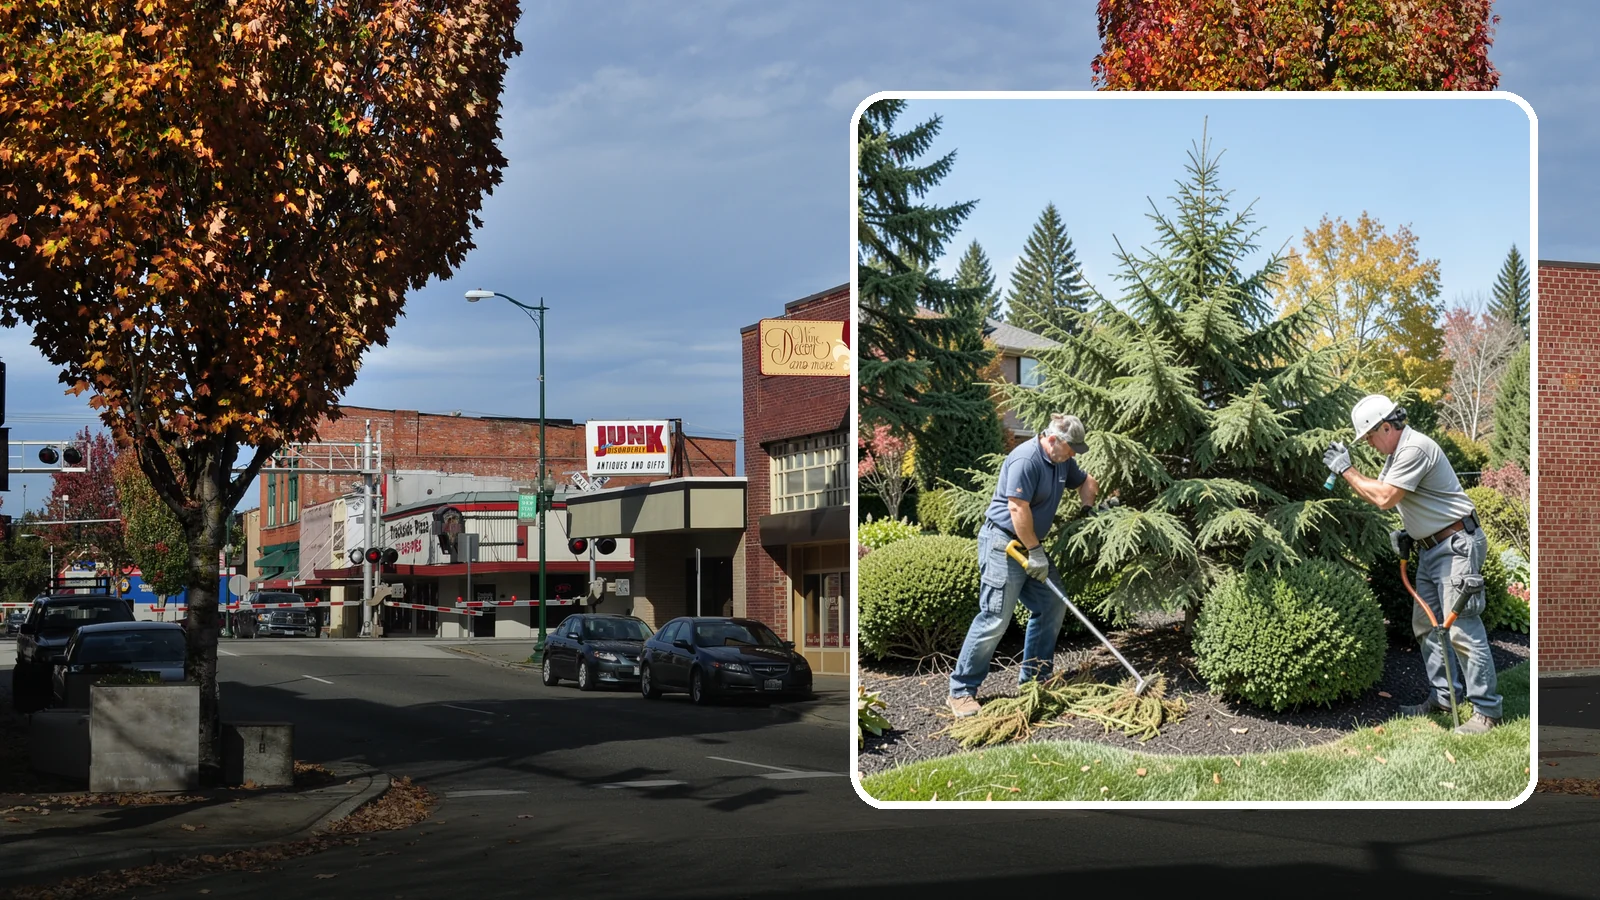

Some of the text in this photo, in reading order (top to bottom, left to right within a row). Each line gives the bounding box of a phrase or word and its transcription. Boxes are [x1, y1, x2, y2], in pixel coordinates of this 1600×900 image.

[596, 425, 665, 457] JUNK
[608, 446, 646, 454] DISORDERLY
[597, 460, 665, 470] ANTIQUES AND GIFTS
[390, 519, 429, 539] Trackside Pizza
